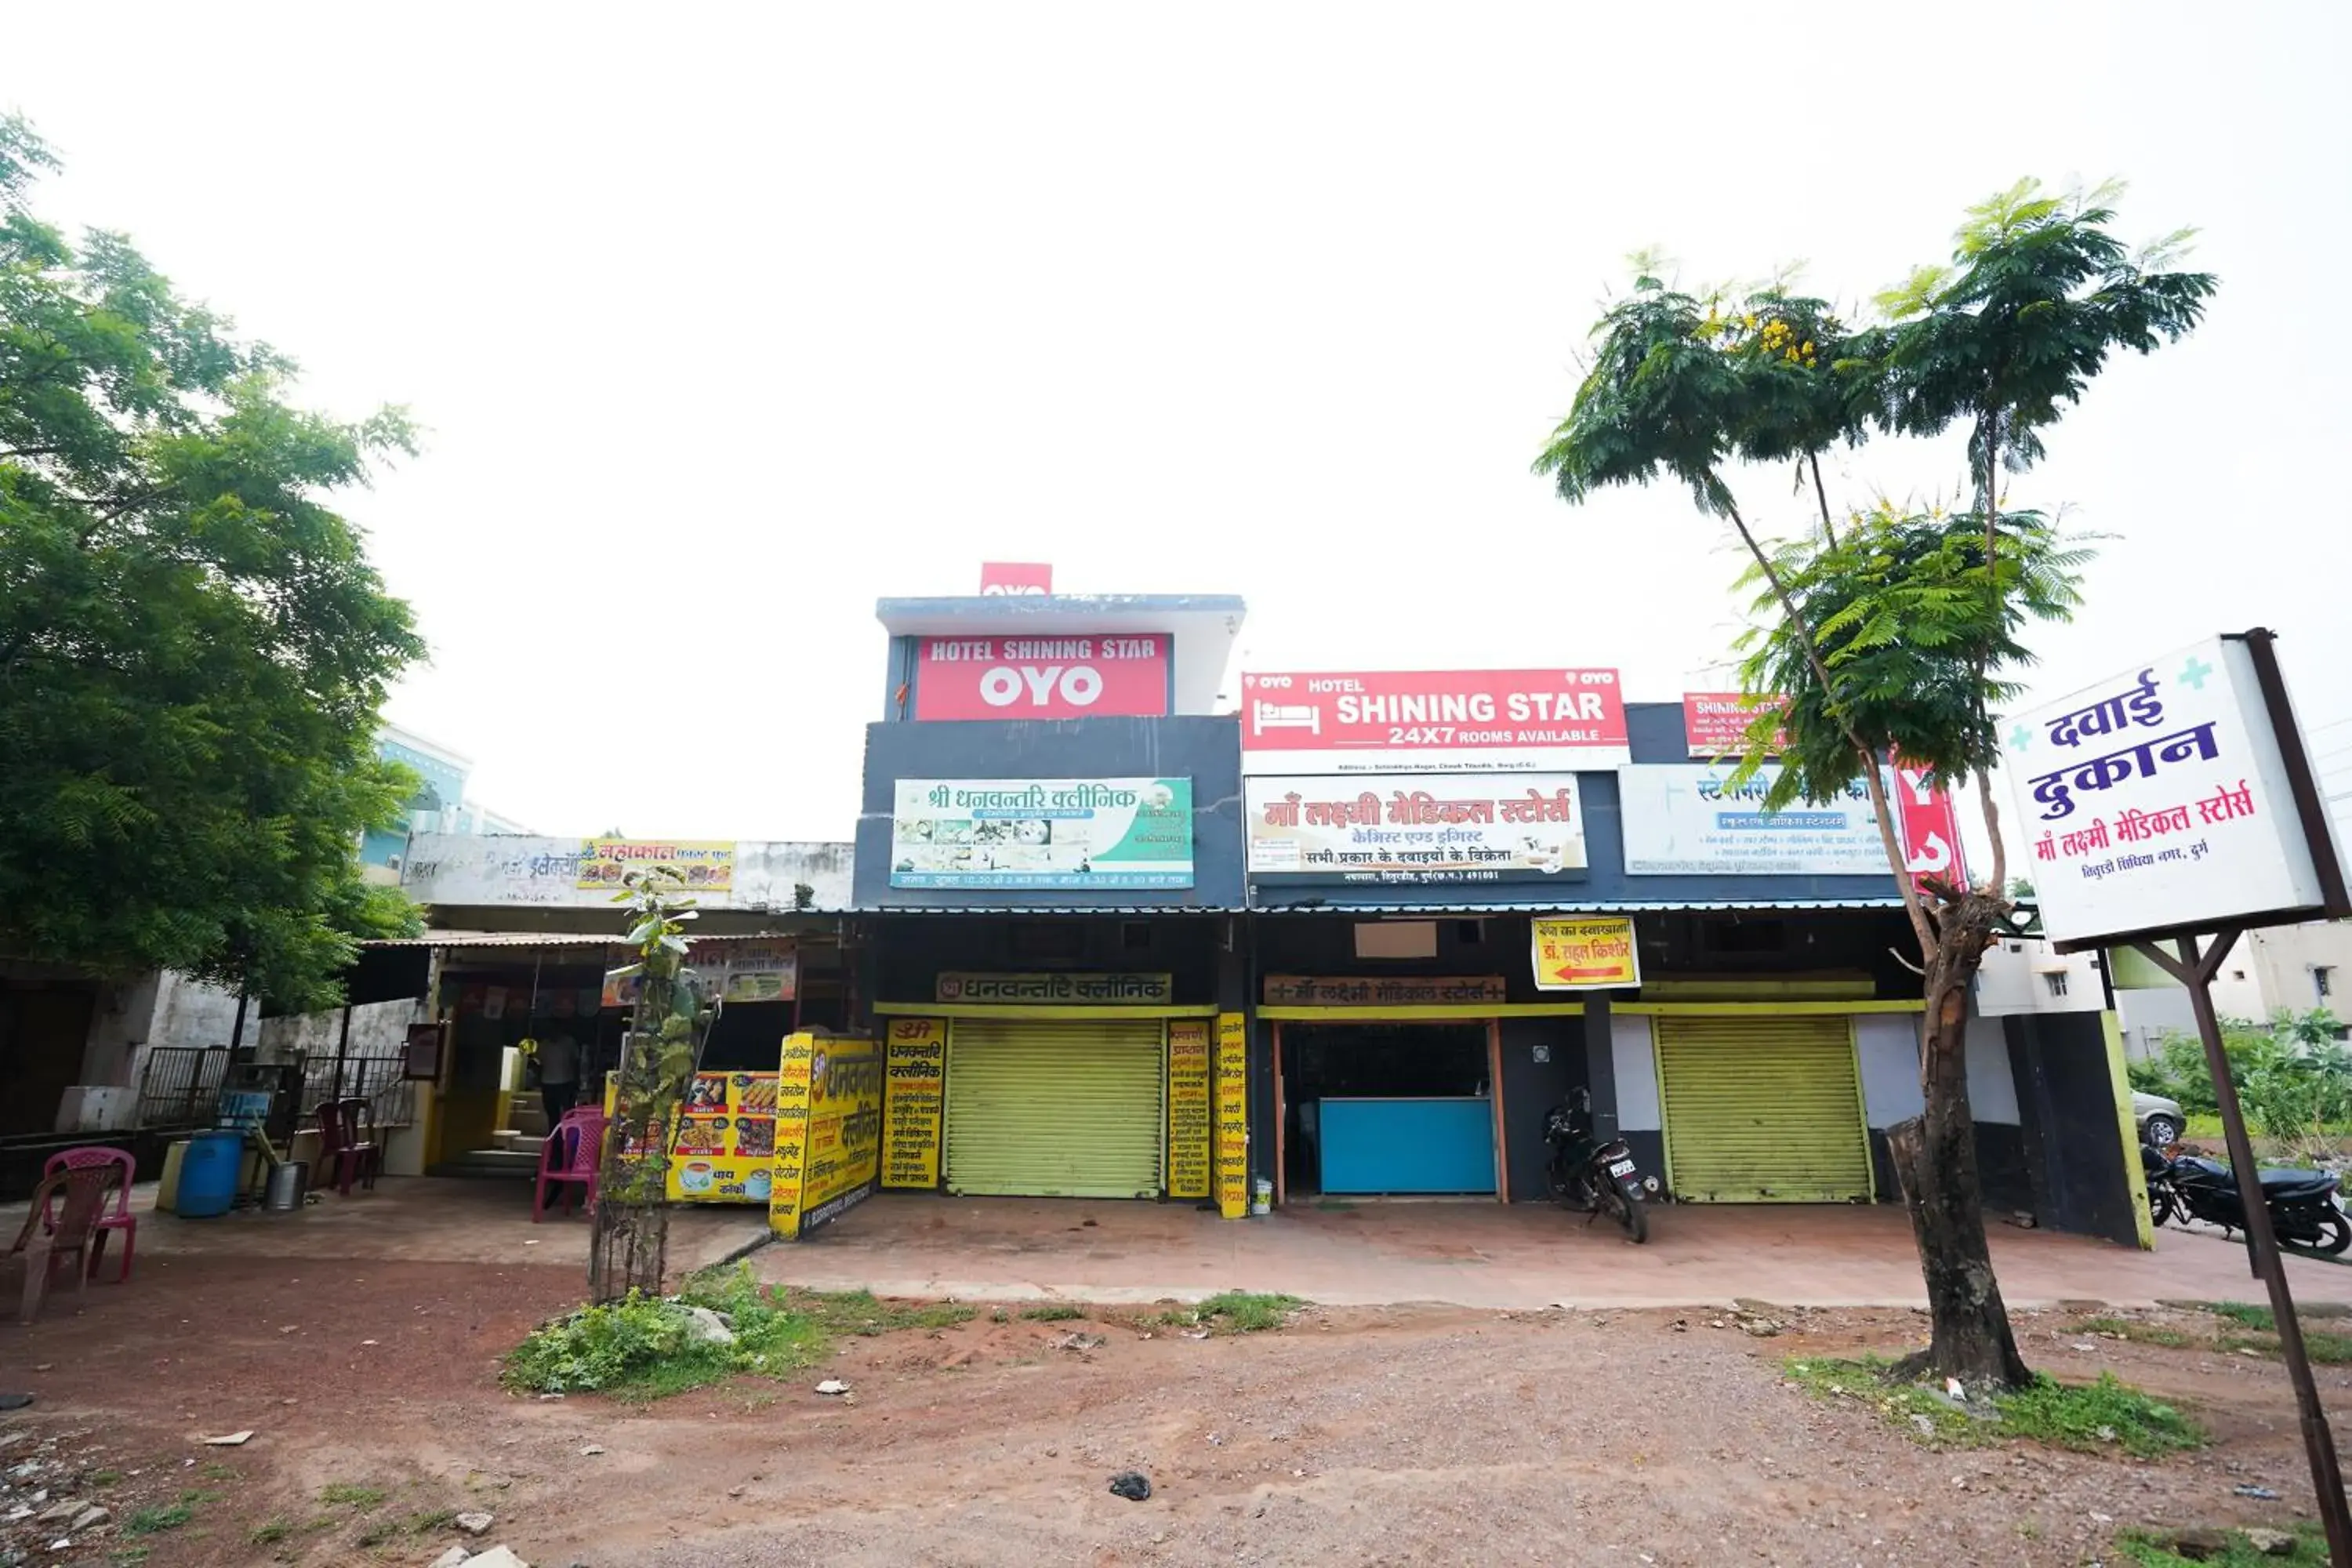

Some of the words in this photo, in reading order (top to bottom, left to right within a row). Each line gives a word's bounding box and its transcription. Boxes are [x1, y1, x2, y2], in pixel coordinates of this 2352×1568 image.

[931, 641, 993, 661] HOTEL
[1004, 640, 1092, 660] SHINING
[1102, 639, 1156, 659] STAR
[980, 666, 1102, 706] OYO
[1259, 676, 1292, 688] OYO
[1308, 679, 1365, 692] HOTEL
[1580, 672, 1613, 684] OYO
[1337, 693, 1496, 724] SHINING
[1508, 692, 1604, 721] STAR
[2045, 668, 2165, 748] दवाई
[1389, 727, 1456, 744] 24X7
[1459, 731, 1513, 743] ROOMS
[1517, 730, 1600, 742] AVAILABLE
[2028, 721, 2220, 821] दुकान
[928, 784, 950, 808] श्री
[956, 784, 1047, 809] धनवन्तरि
[1051, 783, 1136, 809] क्लीनिक
[1264, 790, 1302, 826] माँ
[1305, 791, 1381, 829] लक्ष्मी
[1387, 789, 1494, 825] मेडिकल
[1499, 788, 1571, 824] स्टोर्स
[2034, 830, 2056, 862] माँ
[2060, 818, 2109, 857] लक्ष्मी
[2114, 805, 2191, 843] मेडिकल
[2196, 779, 2255, 825] स्टोर्स
[600, 844, 676, 862] महाकाल
[1306, 848, 1334, 864] सभी
[1338, 851, 1374, 863] प्रकार
[1377, 849, 1392, 862] के
[1451, 848, 1463, 863] के
[1468, 847, 1512, 864] विक्रेता
[2190, 838, 2209, 861] दुर्ग
[1076, 976, 1167, 998] क्लीनिक
[895, 1021, 931, 1040] श्री
